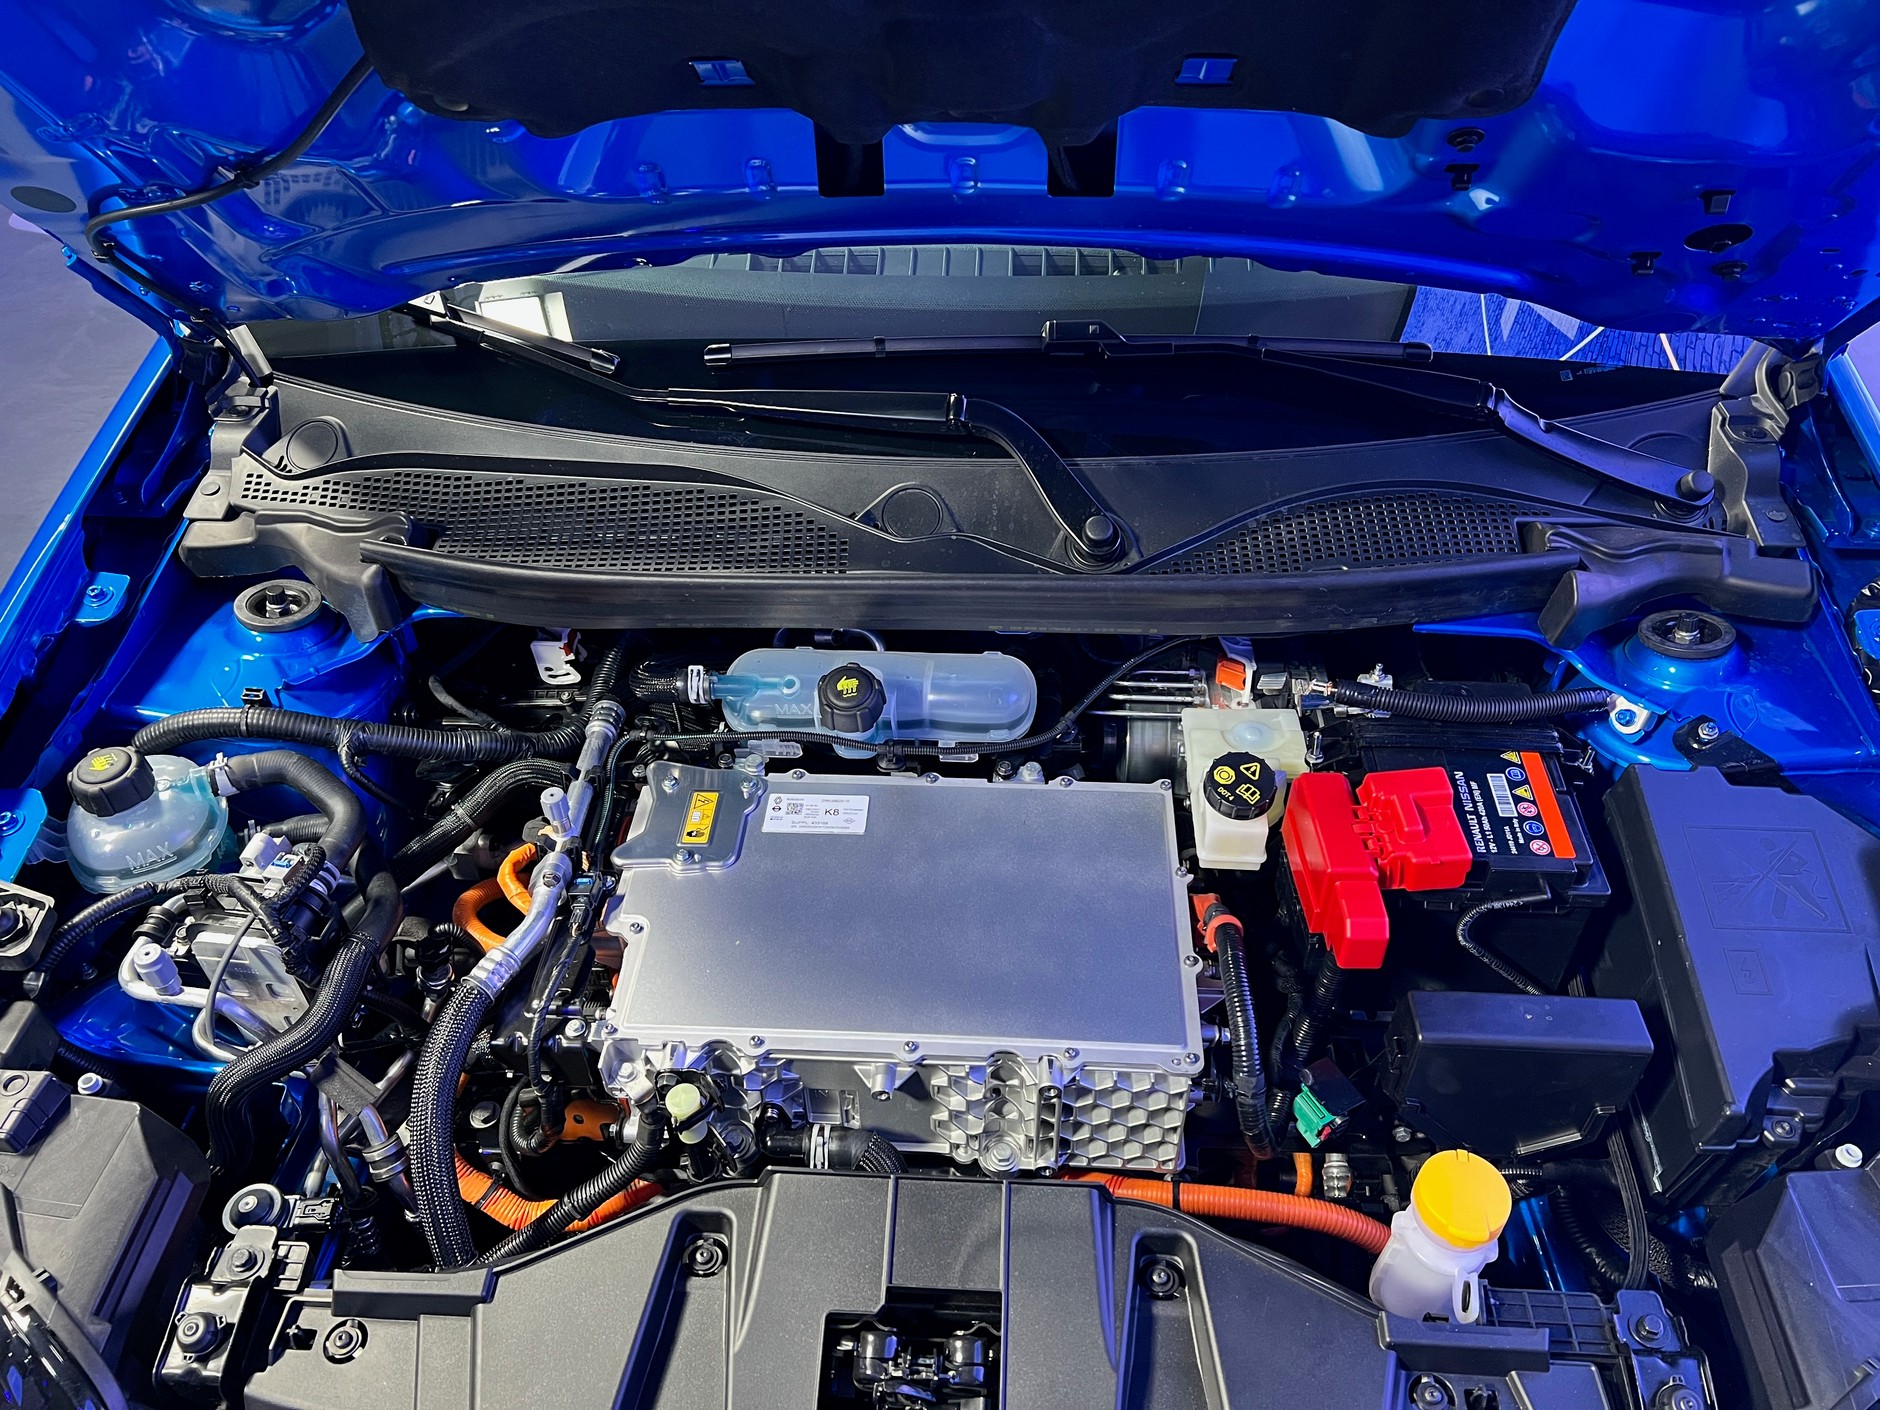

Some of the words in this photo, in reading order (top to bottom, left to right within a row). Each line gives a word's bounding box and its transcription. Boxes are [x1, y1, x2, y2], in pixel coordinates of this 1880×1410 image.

[774, 703, 813, 715] MAX
[1469, 780, 1479, 789] MF
[1217, 786, 1232, 798] DOT
[1453, 771, 1475, 811] NISSAN
[824, 808, 840, 816] K8
[1466, 813, 1487, 853] RENAULT
[1485, 831, 1494, 839] L1
[1488, 842, 1498, 853] 12V
[126, 841, 174, 870] MAX
